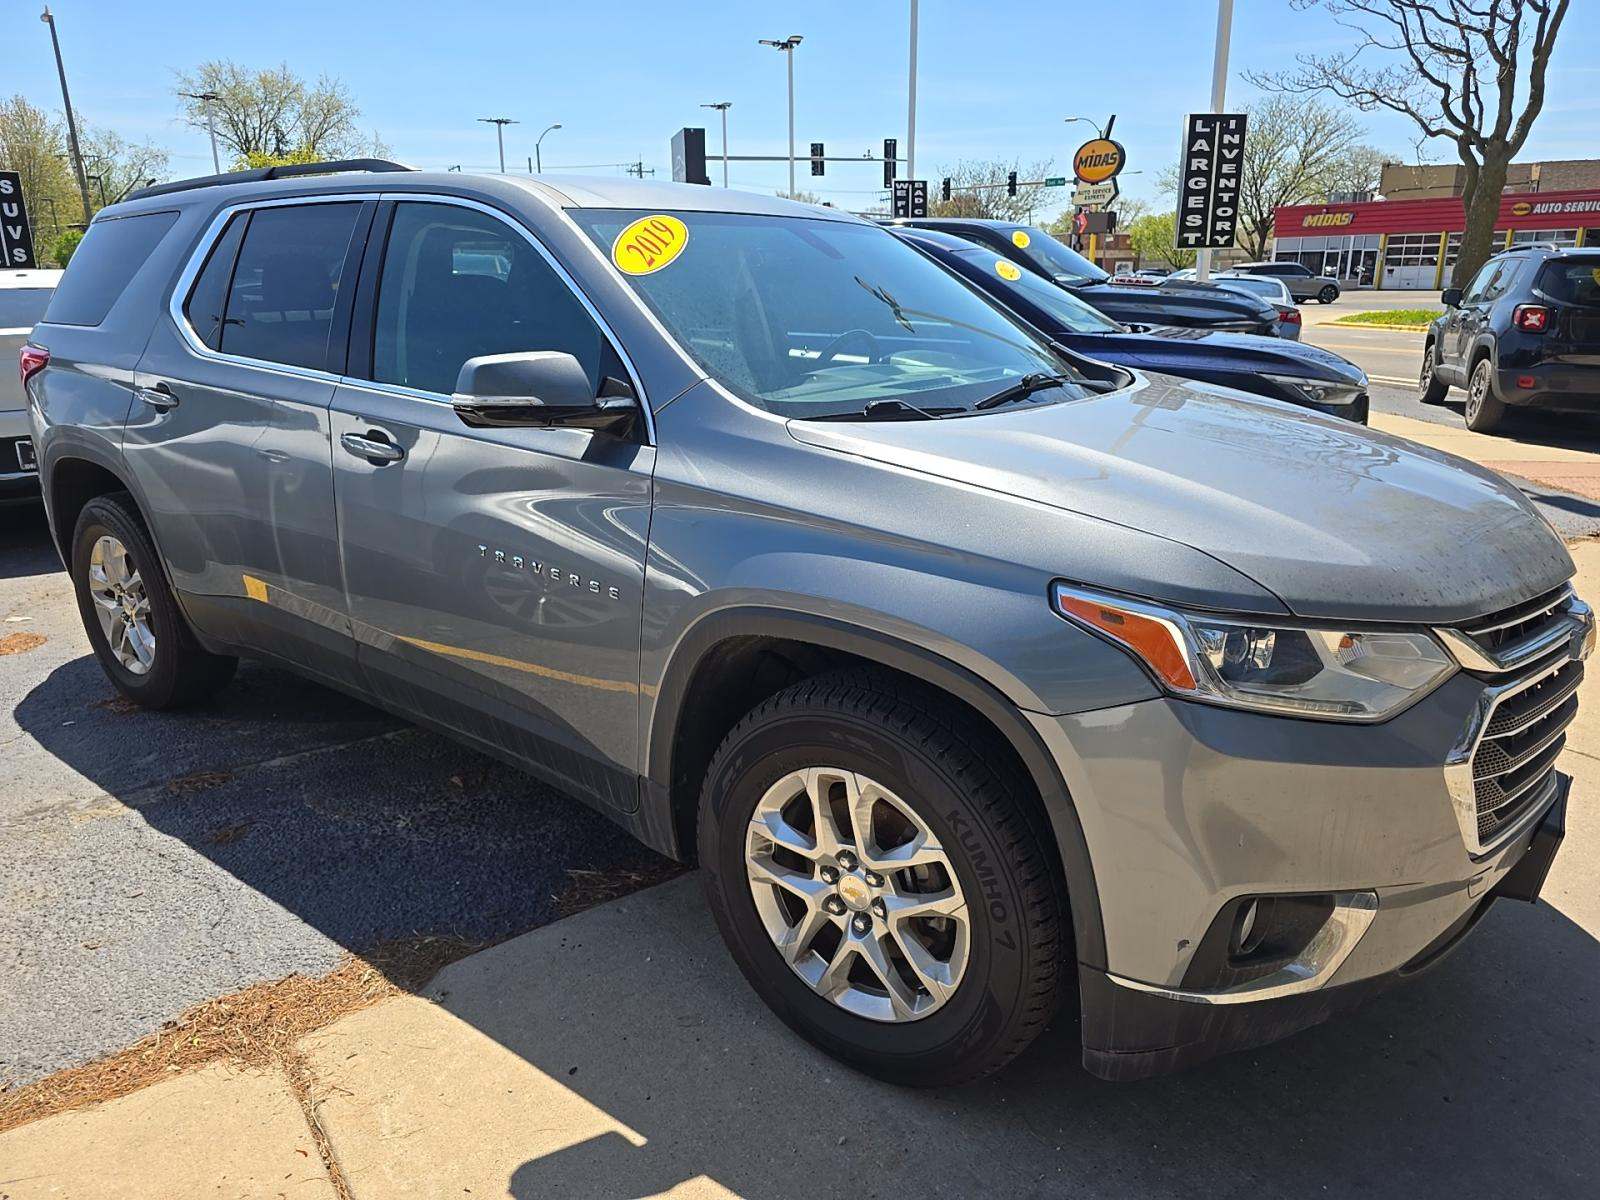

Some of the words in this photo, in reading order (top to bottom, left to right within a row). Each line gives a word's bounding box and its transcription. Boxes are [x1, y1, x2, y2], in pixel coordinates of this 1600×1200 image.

[1077, 149, 1118, 168] MIDAS
[1183, 119, 1211, 245] LARGEST
[1214, 119, 1240, 245] INVENTORY
[0, 179, 28, 263] SUVS
[1302, 208, 1351, 228] MIDAS
[1533, 202, 1562, 214] AUTO
[626, 219, 675, 268] 2019
[478, 543, 620, 600] TRAVERSE
[945, 809, 1007, 924] KUMHO
